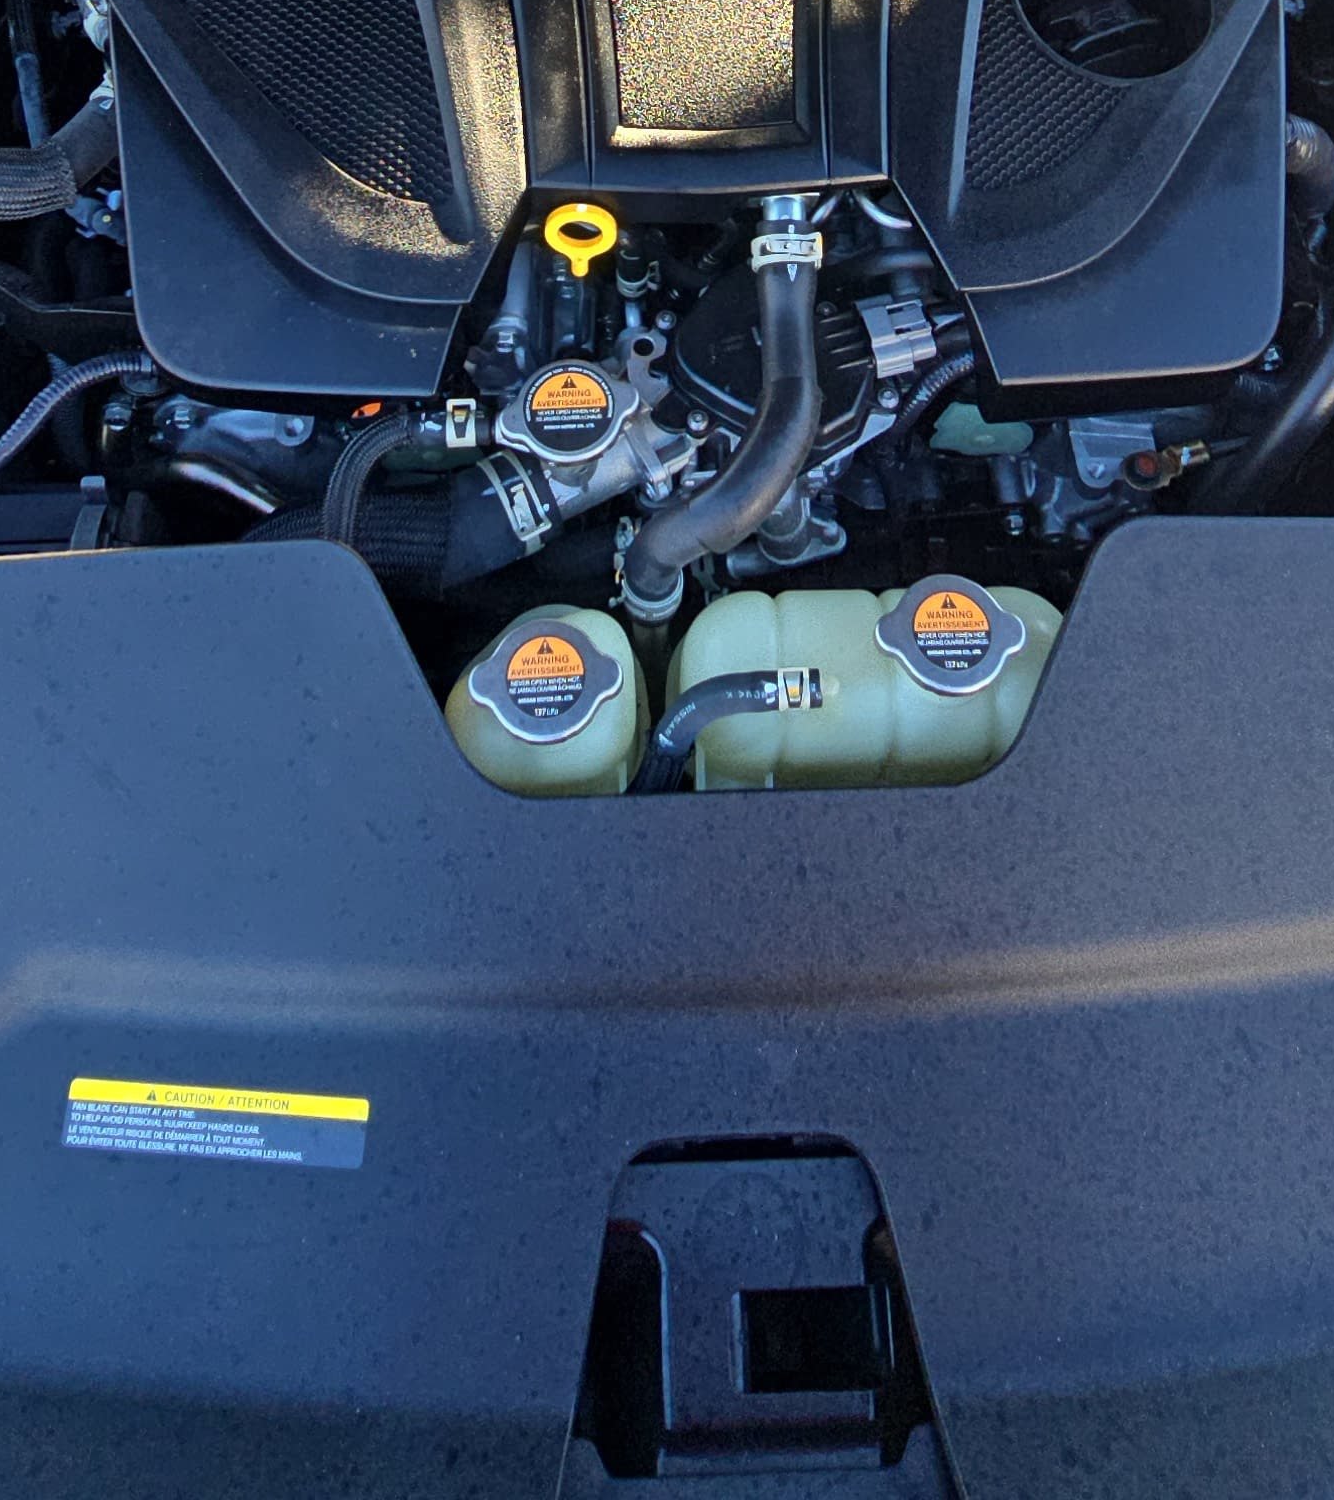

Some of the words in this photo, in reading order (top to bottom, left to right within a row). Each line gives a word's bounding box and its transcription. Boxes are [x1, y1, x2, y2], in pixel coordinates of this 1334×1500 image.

[547, 389, 591, 398] WARNING
[536, 398, 602, 406] AVERTISSEMENT
[926, 611, 973, 619] WARNING
[521, 655, 569, 666] WARNING
[511, 665, 580, 676] AVERTISSEMENT
[164, 1091, 215, 1105] CAUTION
[228, 1096, 290, 1110] ATTENTION
[72, 1102, 86, 1110] FAN
[112, 1105, 127, 1114] CAN
[129, 1106, 151, 1115] START
[152, 1108, 160, 1116] AT
[101, 1115, 123, 1124] AVOID
[68, 1125, 78, 1134] LE
[153, 1130, 164, 1139] DE
[263, 1150, 277, 1159] LES
